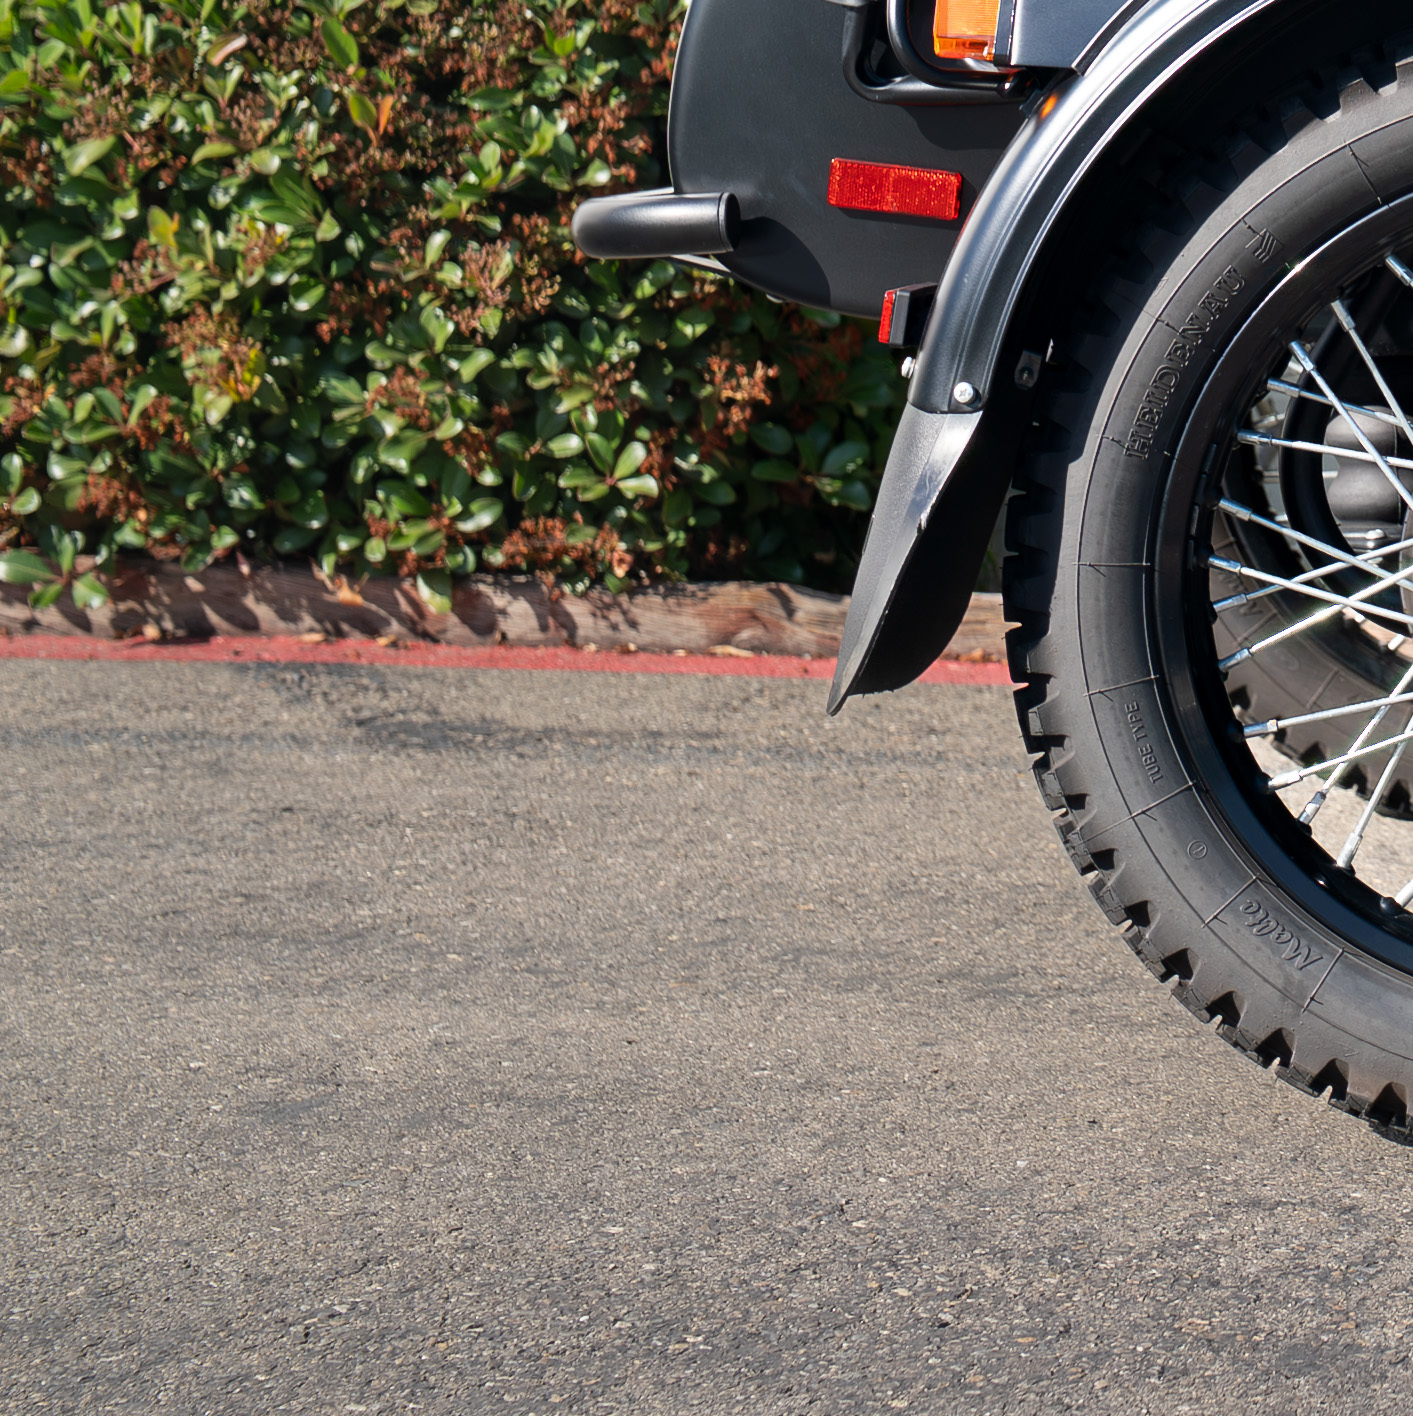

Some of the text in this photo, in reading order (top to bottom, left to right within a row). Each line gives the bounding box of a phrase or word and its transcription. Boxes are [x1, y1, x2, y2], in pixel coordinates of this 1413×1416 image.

[1122, 263, 1247, 461] HEIDENAU
[1124, 699, 1164, 785] TUBE TYPE
